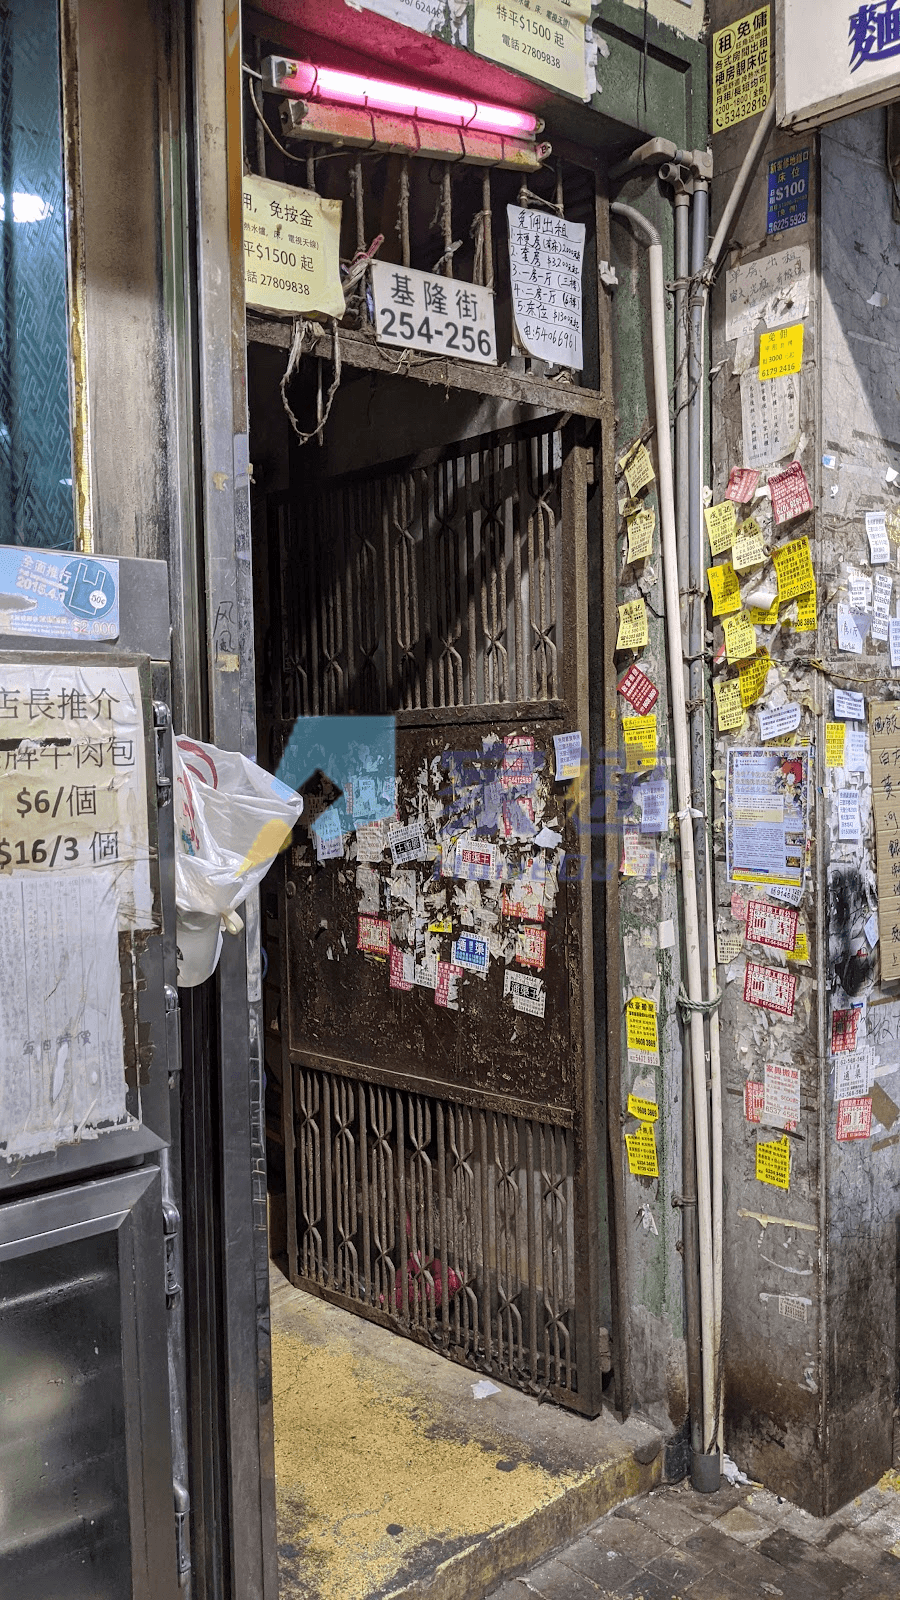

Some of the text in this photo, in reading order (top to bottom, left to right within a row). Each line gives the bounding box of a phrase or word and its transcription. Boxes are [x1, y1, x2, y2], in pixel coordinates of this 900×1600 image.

[501, 33, 561, 69] 電話 27809838
[554, 31, 565, 49] 起
[718, 34, 732, 54] 租
[724, 94, 767, 125] 53432818
[776, 179, 805, 201] $100
[300, 254, 314, 273] 起
[260, 273, 310, 296] 27809838
[391, 273, 478, 323] 基隆街
[380, 308, 492, 357] 254-256
[761, 363, 796, 378] 6179 2416
[71, 618, 117, 636] $2,000
[0, 687, 120, 721] 店長推介
[16, 785, 97, 818] $6/個
[0, 831, 119, 870] $16/3 個
